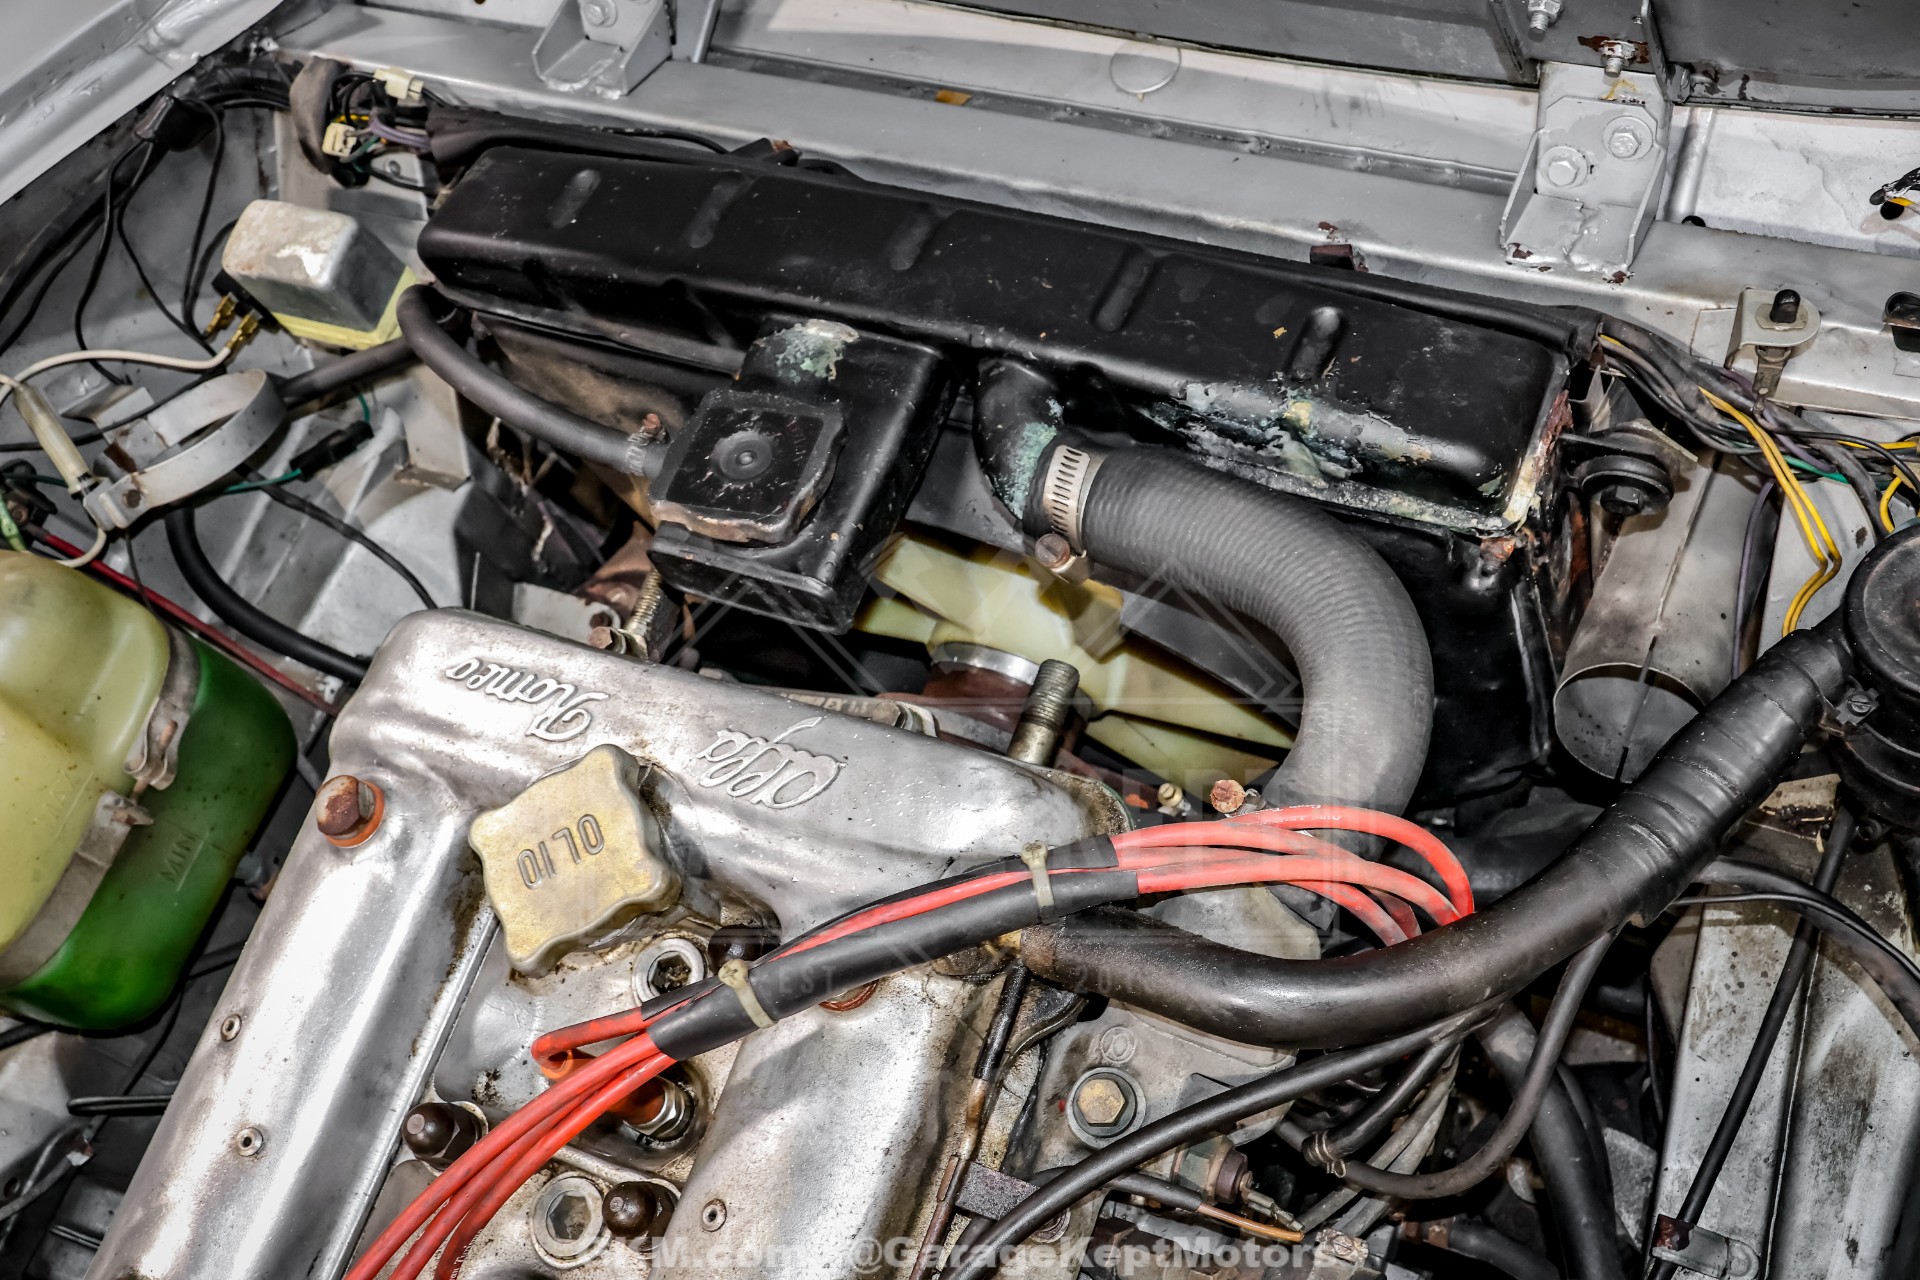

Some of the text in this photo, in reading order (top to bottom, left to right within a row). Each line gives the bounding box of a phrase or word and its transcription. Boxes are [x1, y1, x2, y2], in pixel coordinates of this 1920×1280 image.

[445, 657, 849, 810] Alfa Romeo
[157, 830, 201, 883] MIN
[516, 812, 606, 891] OLIO
